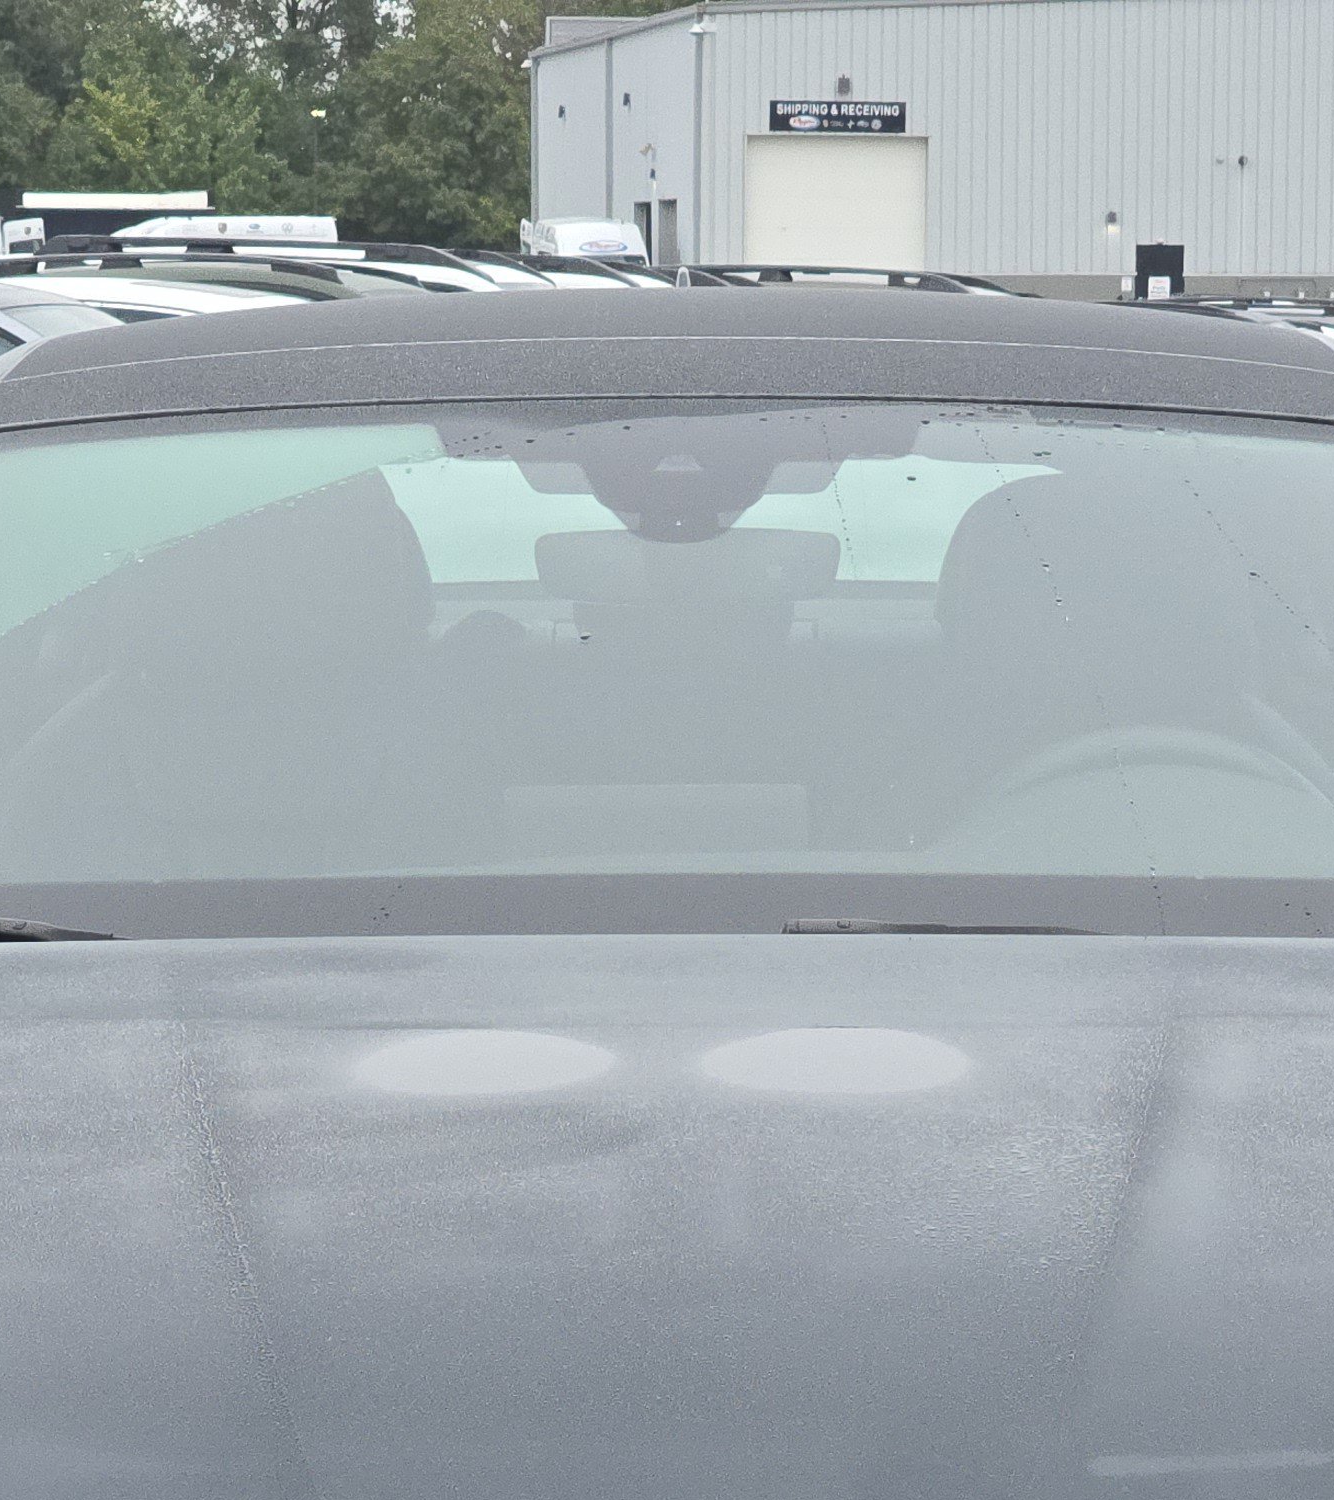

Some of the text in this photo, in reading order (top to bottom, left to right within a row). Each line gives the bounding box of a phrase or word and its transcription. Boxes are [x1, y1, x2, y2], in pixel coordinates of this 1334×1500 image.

[776, 103, 900, 117] SHIPPING & RECEIVING
